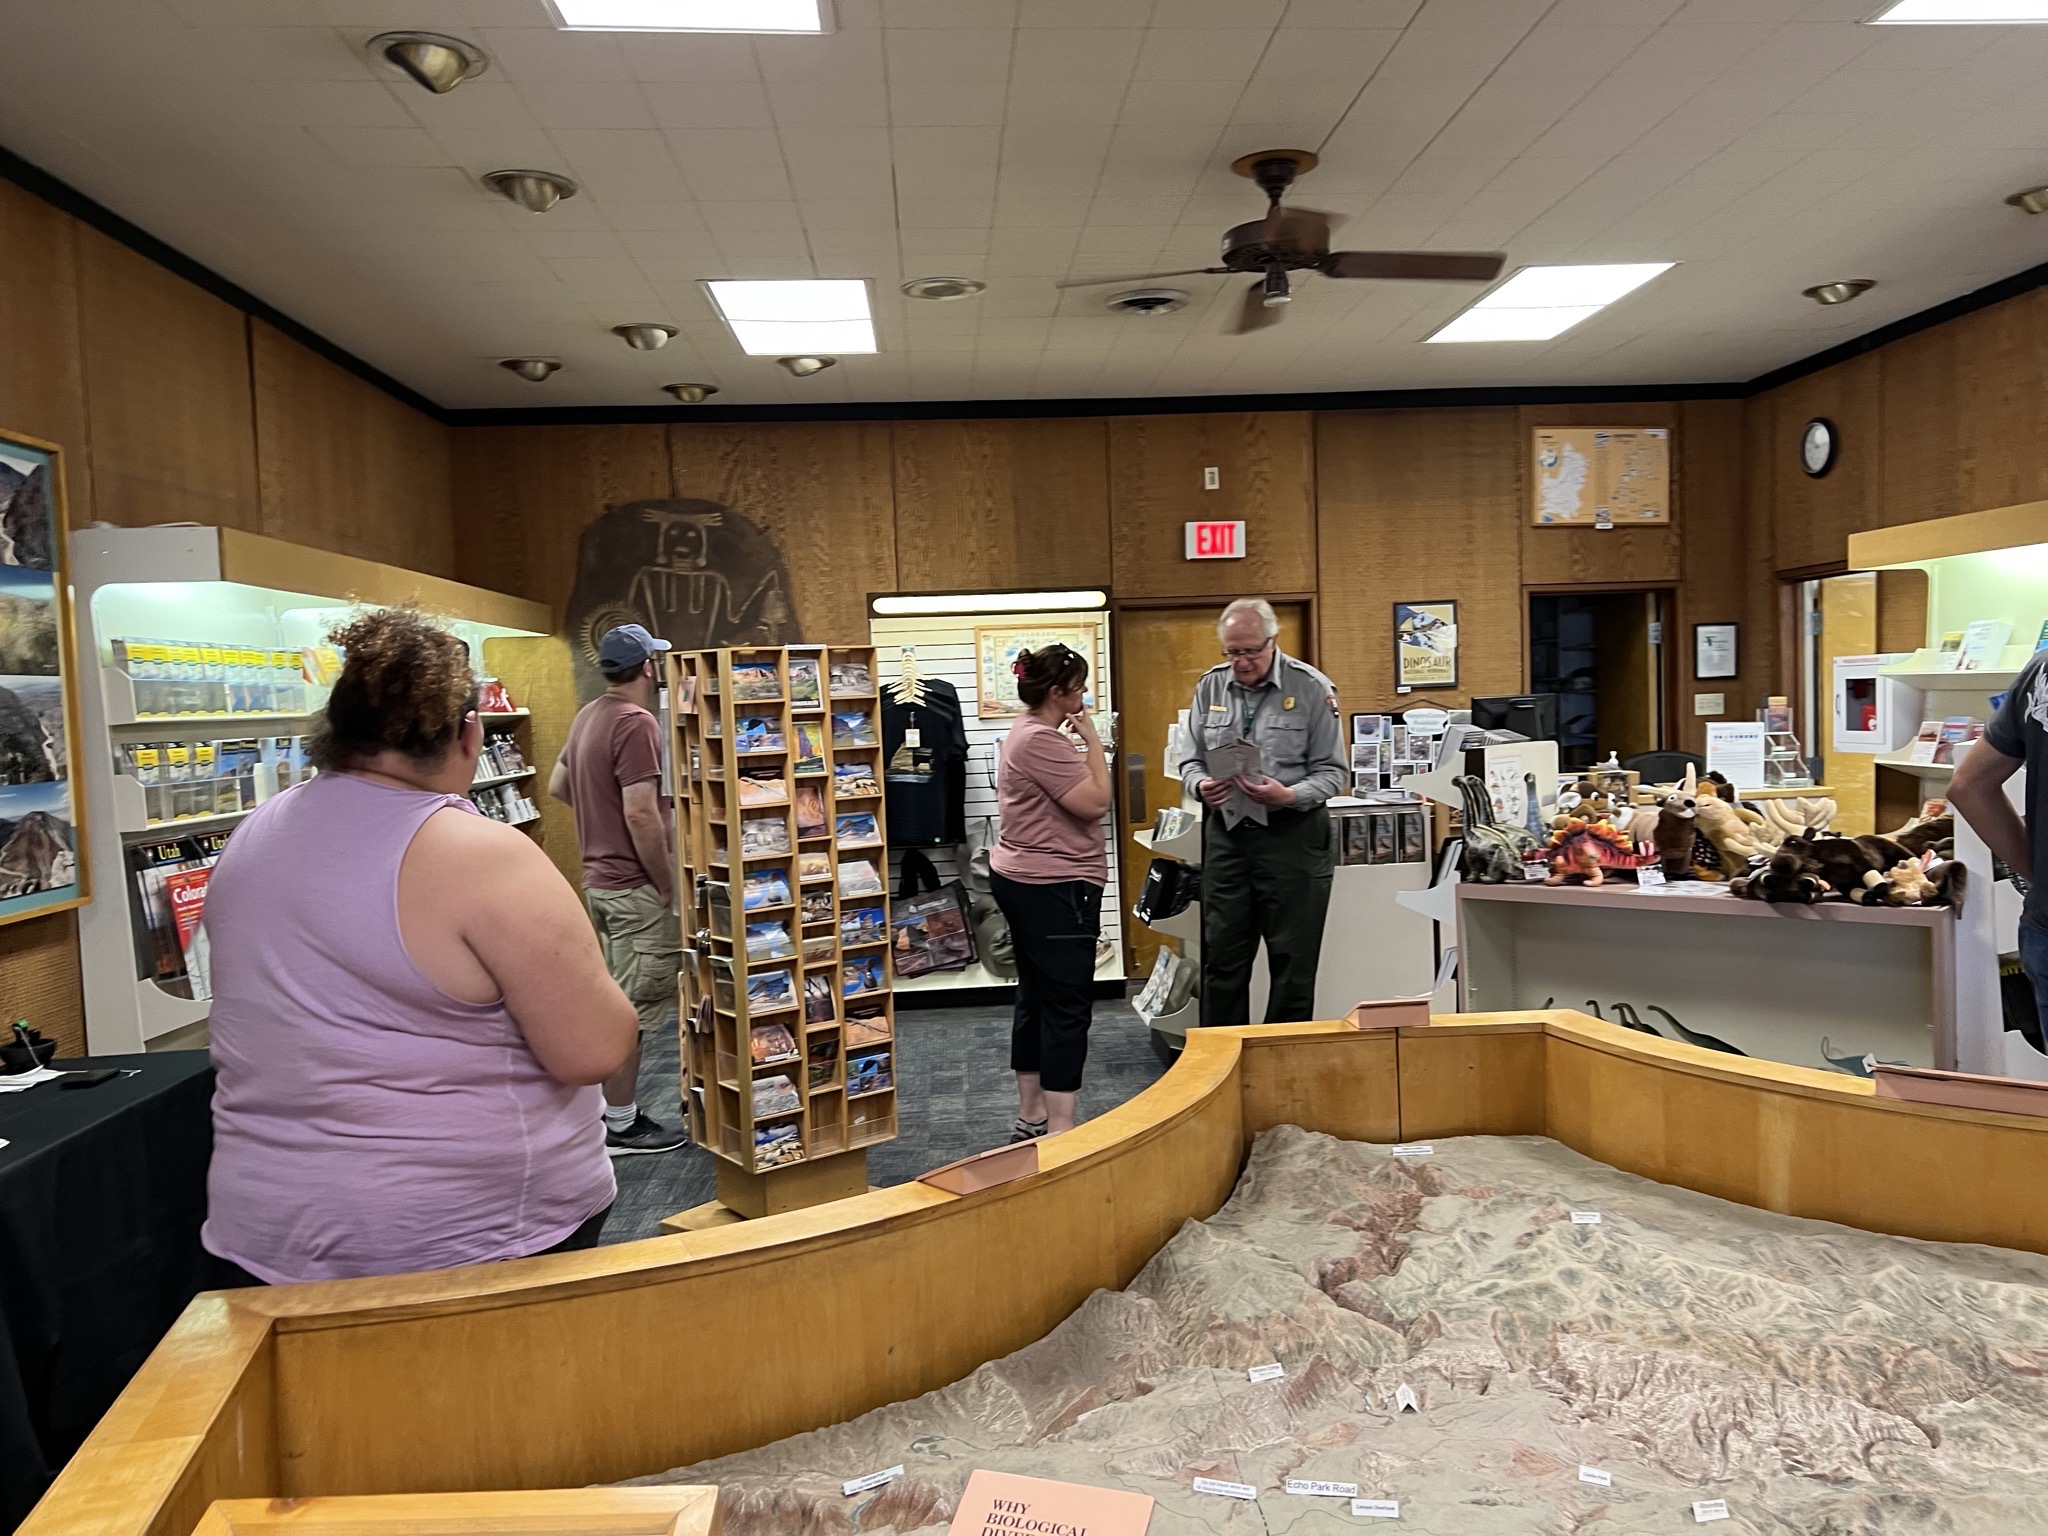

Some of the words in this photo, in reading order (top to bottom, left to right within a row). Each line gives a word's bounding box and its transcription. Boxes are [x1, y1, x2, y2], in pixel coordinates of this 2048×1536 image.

[1196, 523, 1236, 555] EXIT
[1403, 656, 1451, 669] DINOSAUR
[210, 835, 228, 850] Uta
[157, 843, 181, 860] Utah
[173, 881, 208, 904] Colorad
[1287, 1480, 1309, 1490] Echo
[1310, 1481, 1330, 1491] Park
[1332, 1483, 1356, 1494] Road
[993, 1499, 1031, 1515] WHY
[986, 1513, 1087, 1536] BIOLOGICAL
